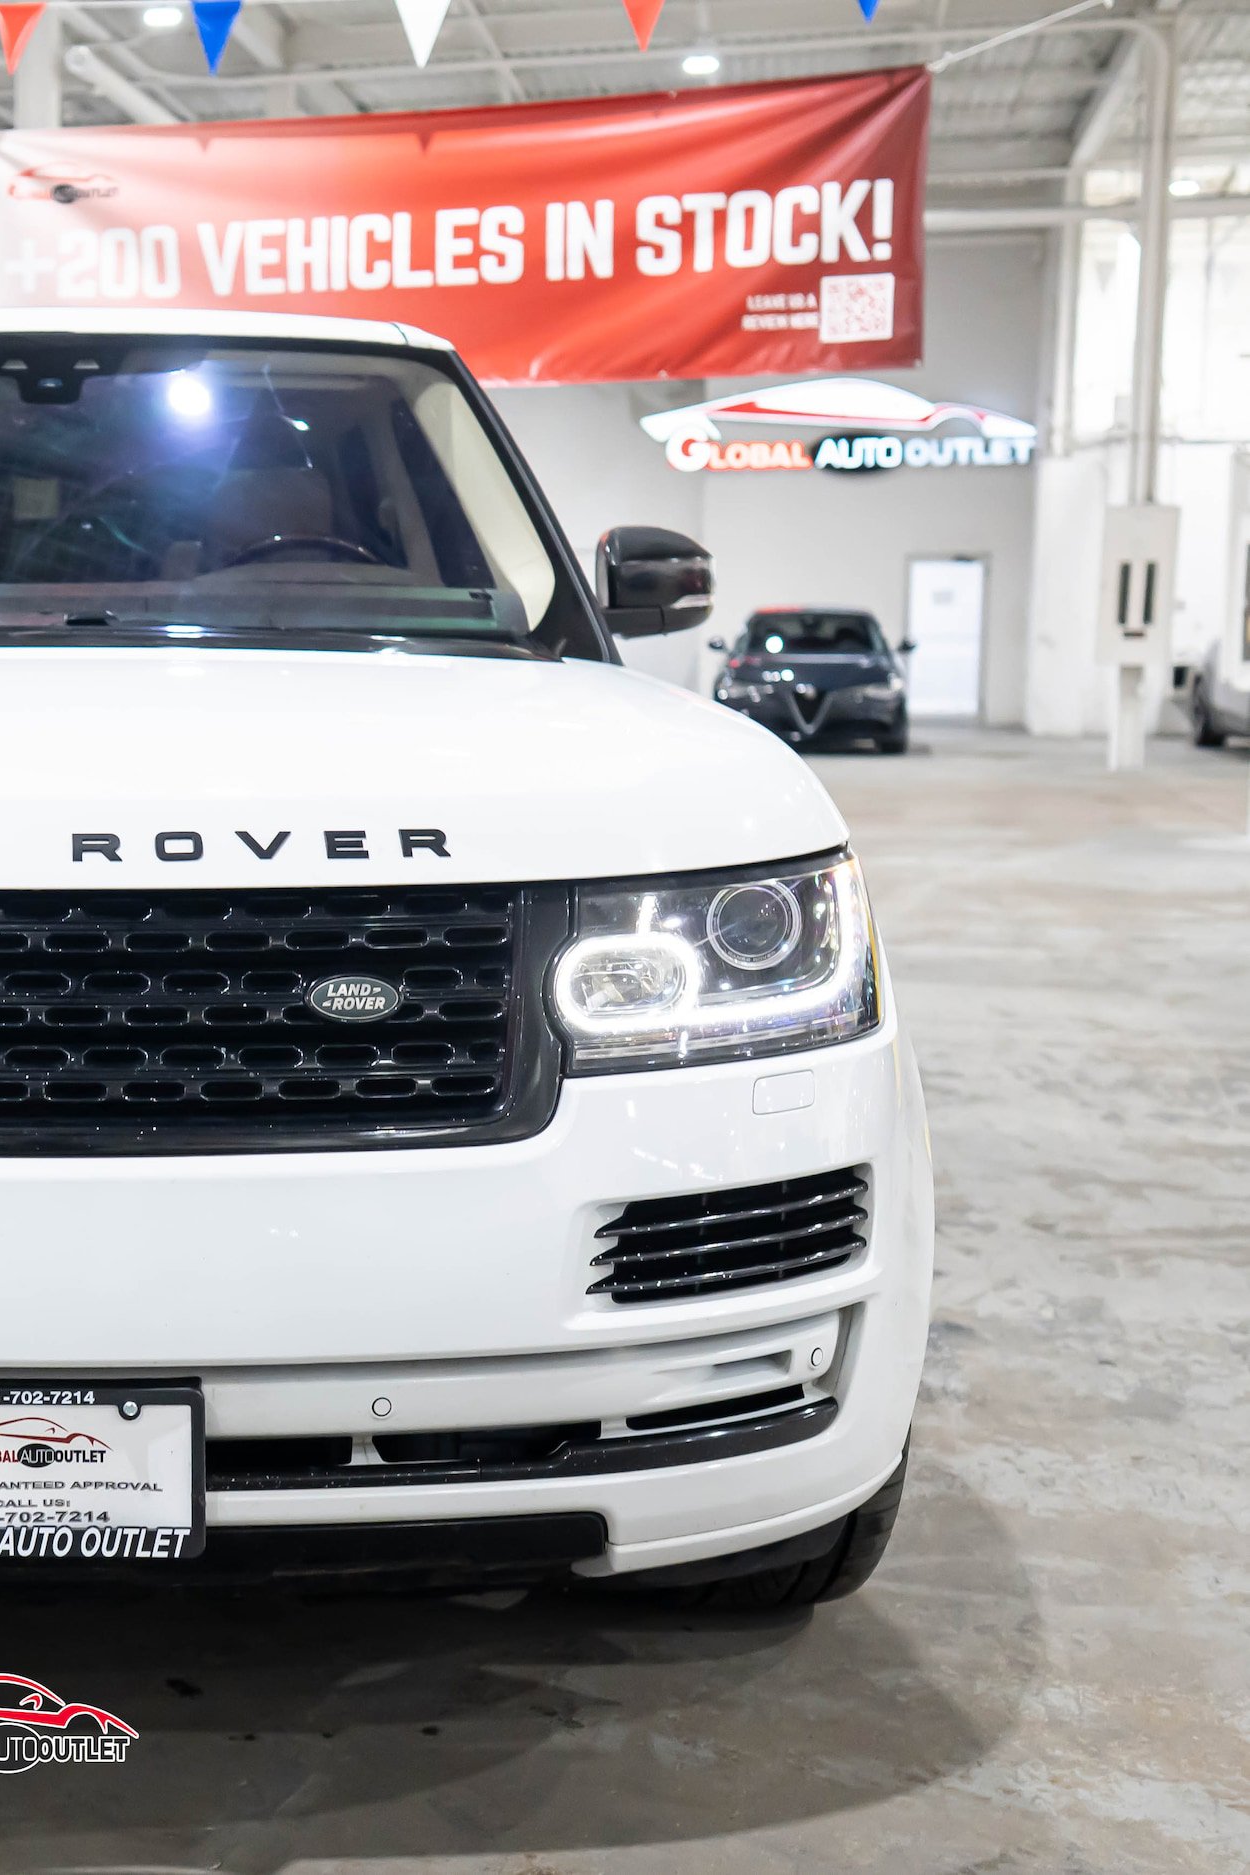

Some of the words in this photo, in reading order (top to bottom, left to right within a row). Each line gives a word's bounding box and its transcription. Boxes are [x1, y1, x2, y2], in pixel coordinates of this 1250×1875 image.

[5, 225, 180, 299] +200
[196, 205, 525, 297] VEHICLES
[545, 199, 615, 281] IN
[635, 178, 894, 277] STOCK!
[666, 425, 812, 472] GLOBAL
[814, 437, 903, 470] AUTO
[903, 437, 1035, 468] OUTLET
[72, 828, 452, 862] ROVER
[327, 983, 372, 998] LAND
[331, 996, 386, 1011] ROVER
[69, 1480, 163, 1492] APPROVAL
[42, 1499, 71, 1508] US:
[80, 1525, 191, 1559] OUTLET
